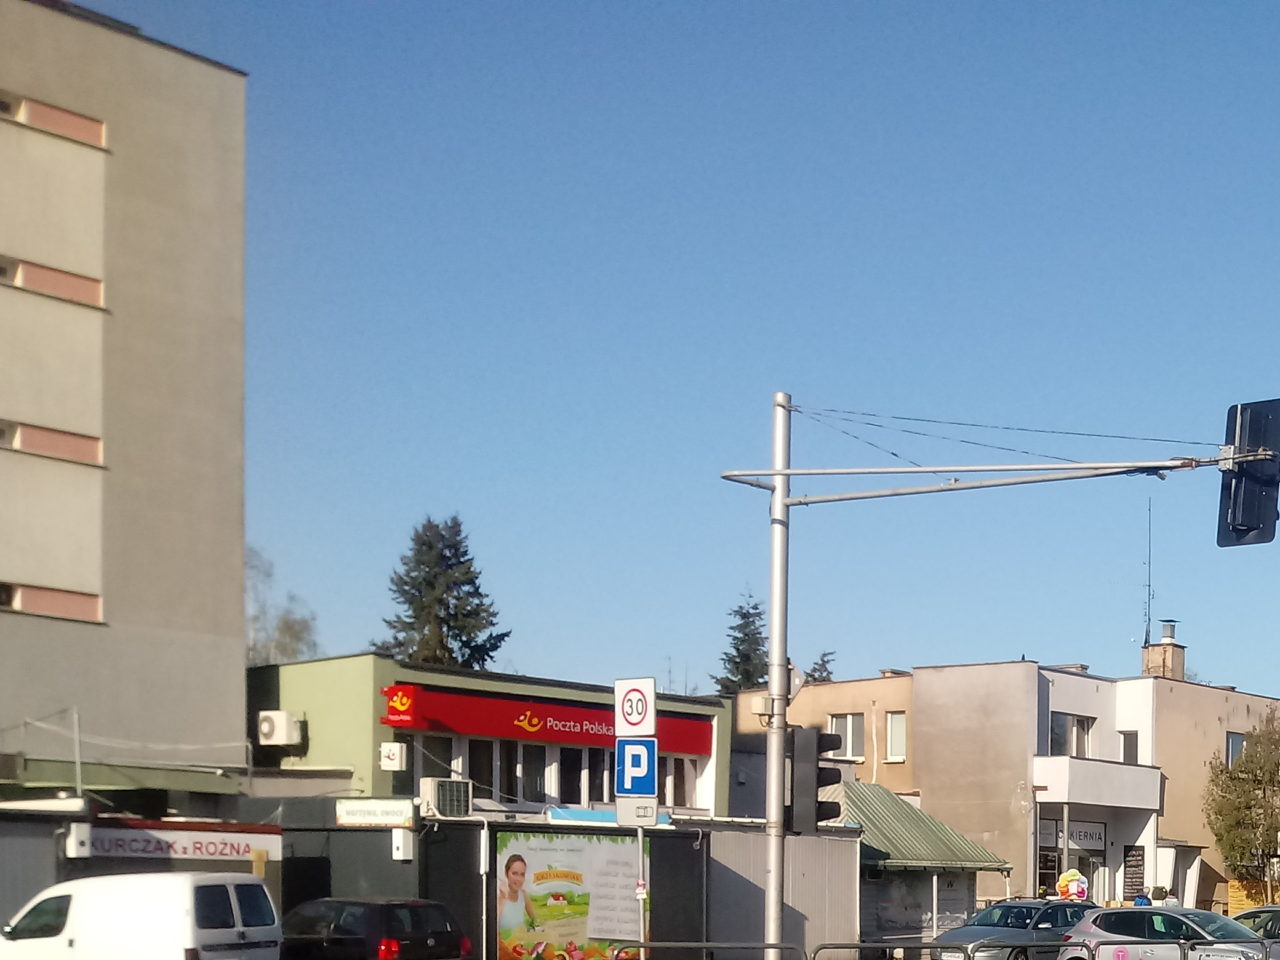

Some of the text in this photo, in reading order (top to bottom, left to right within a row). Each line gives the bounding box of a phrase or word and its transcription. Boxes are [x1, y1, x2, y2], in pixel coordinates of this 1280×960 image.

[625, 701, 645, 717] 30
[546, 717, 614, 737] Poczta Polska
[623, 744, 648, 790] P
[1058, 830, 1103, 841] CKIERNIA
